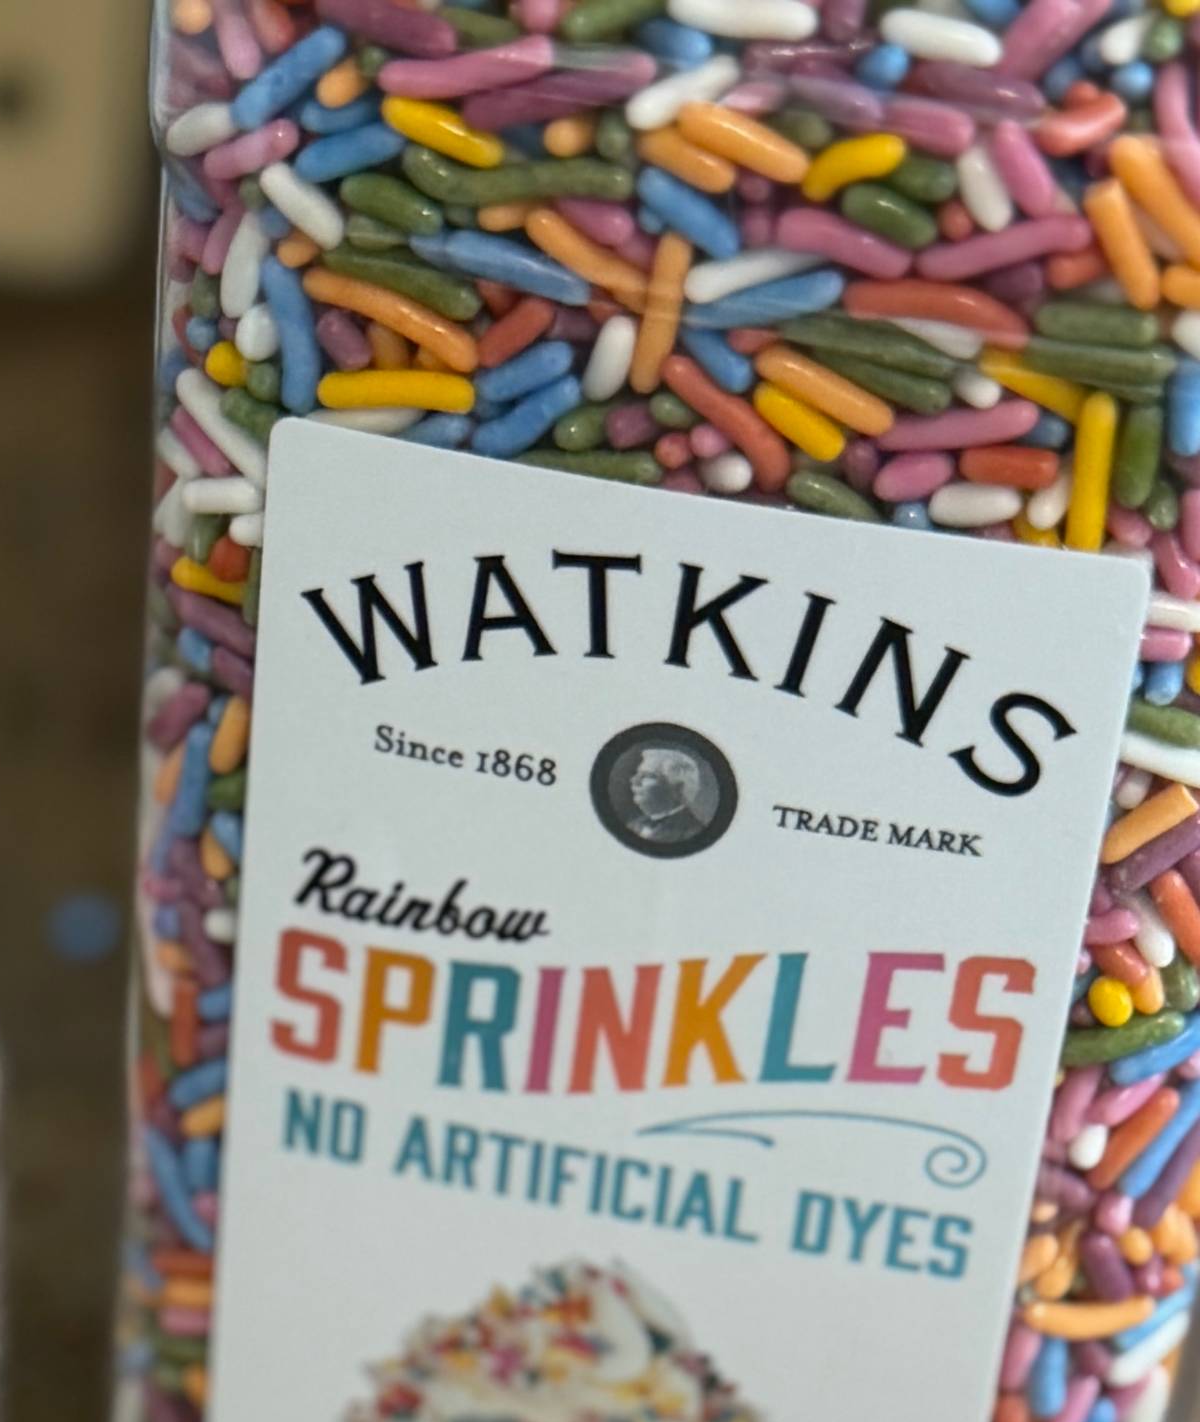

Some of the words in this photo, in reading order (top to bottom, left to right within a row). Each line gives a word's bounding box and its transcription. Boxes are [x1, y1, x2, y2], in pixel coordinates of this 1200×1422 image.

[300, 547, 1081, 798] WATKINS
[372, 724, 465, 772] Since
[475, 751, 559, 788] 1868
[293, 846, 551, 945] Rainbow
[772, 804, 879, 843] TRADE
[886, 823, 983, 858] MARK
[270, 926, 1037, 1096] SPRINKLES
[282, 1087, 367, 1163] NO
[394, 1115, 760, 1244] ARTIFICIAL
[790, 1189, 974, 1281] DYES
